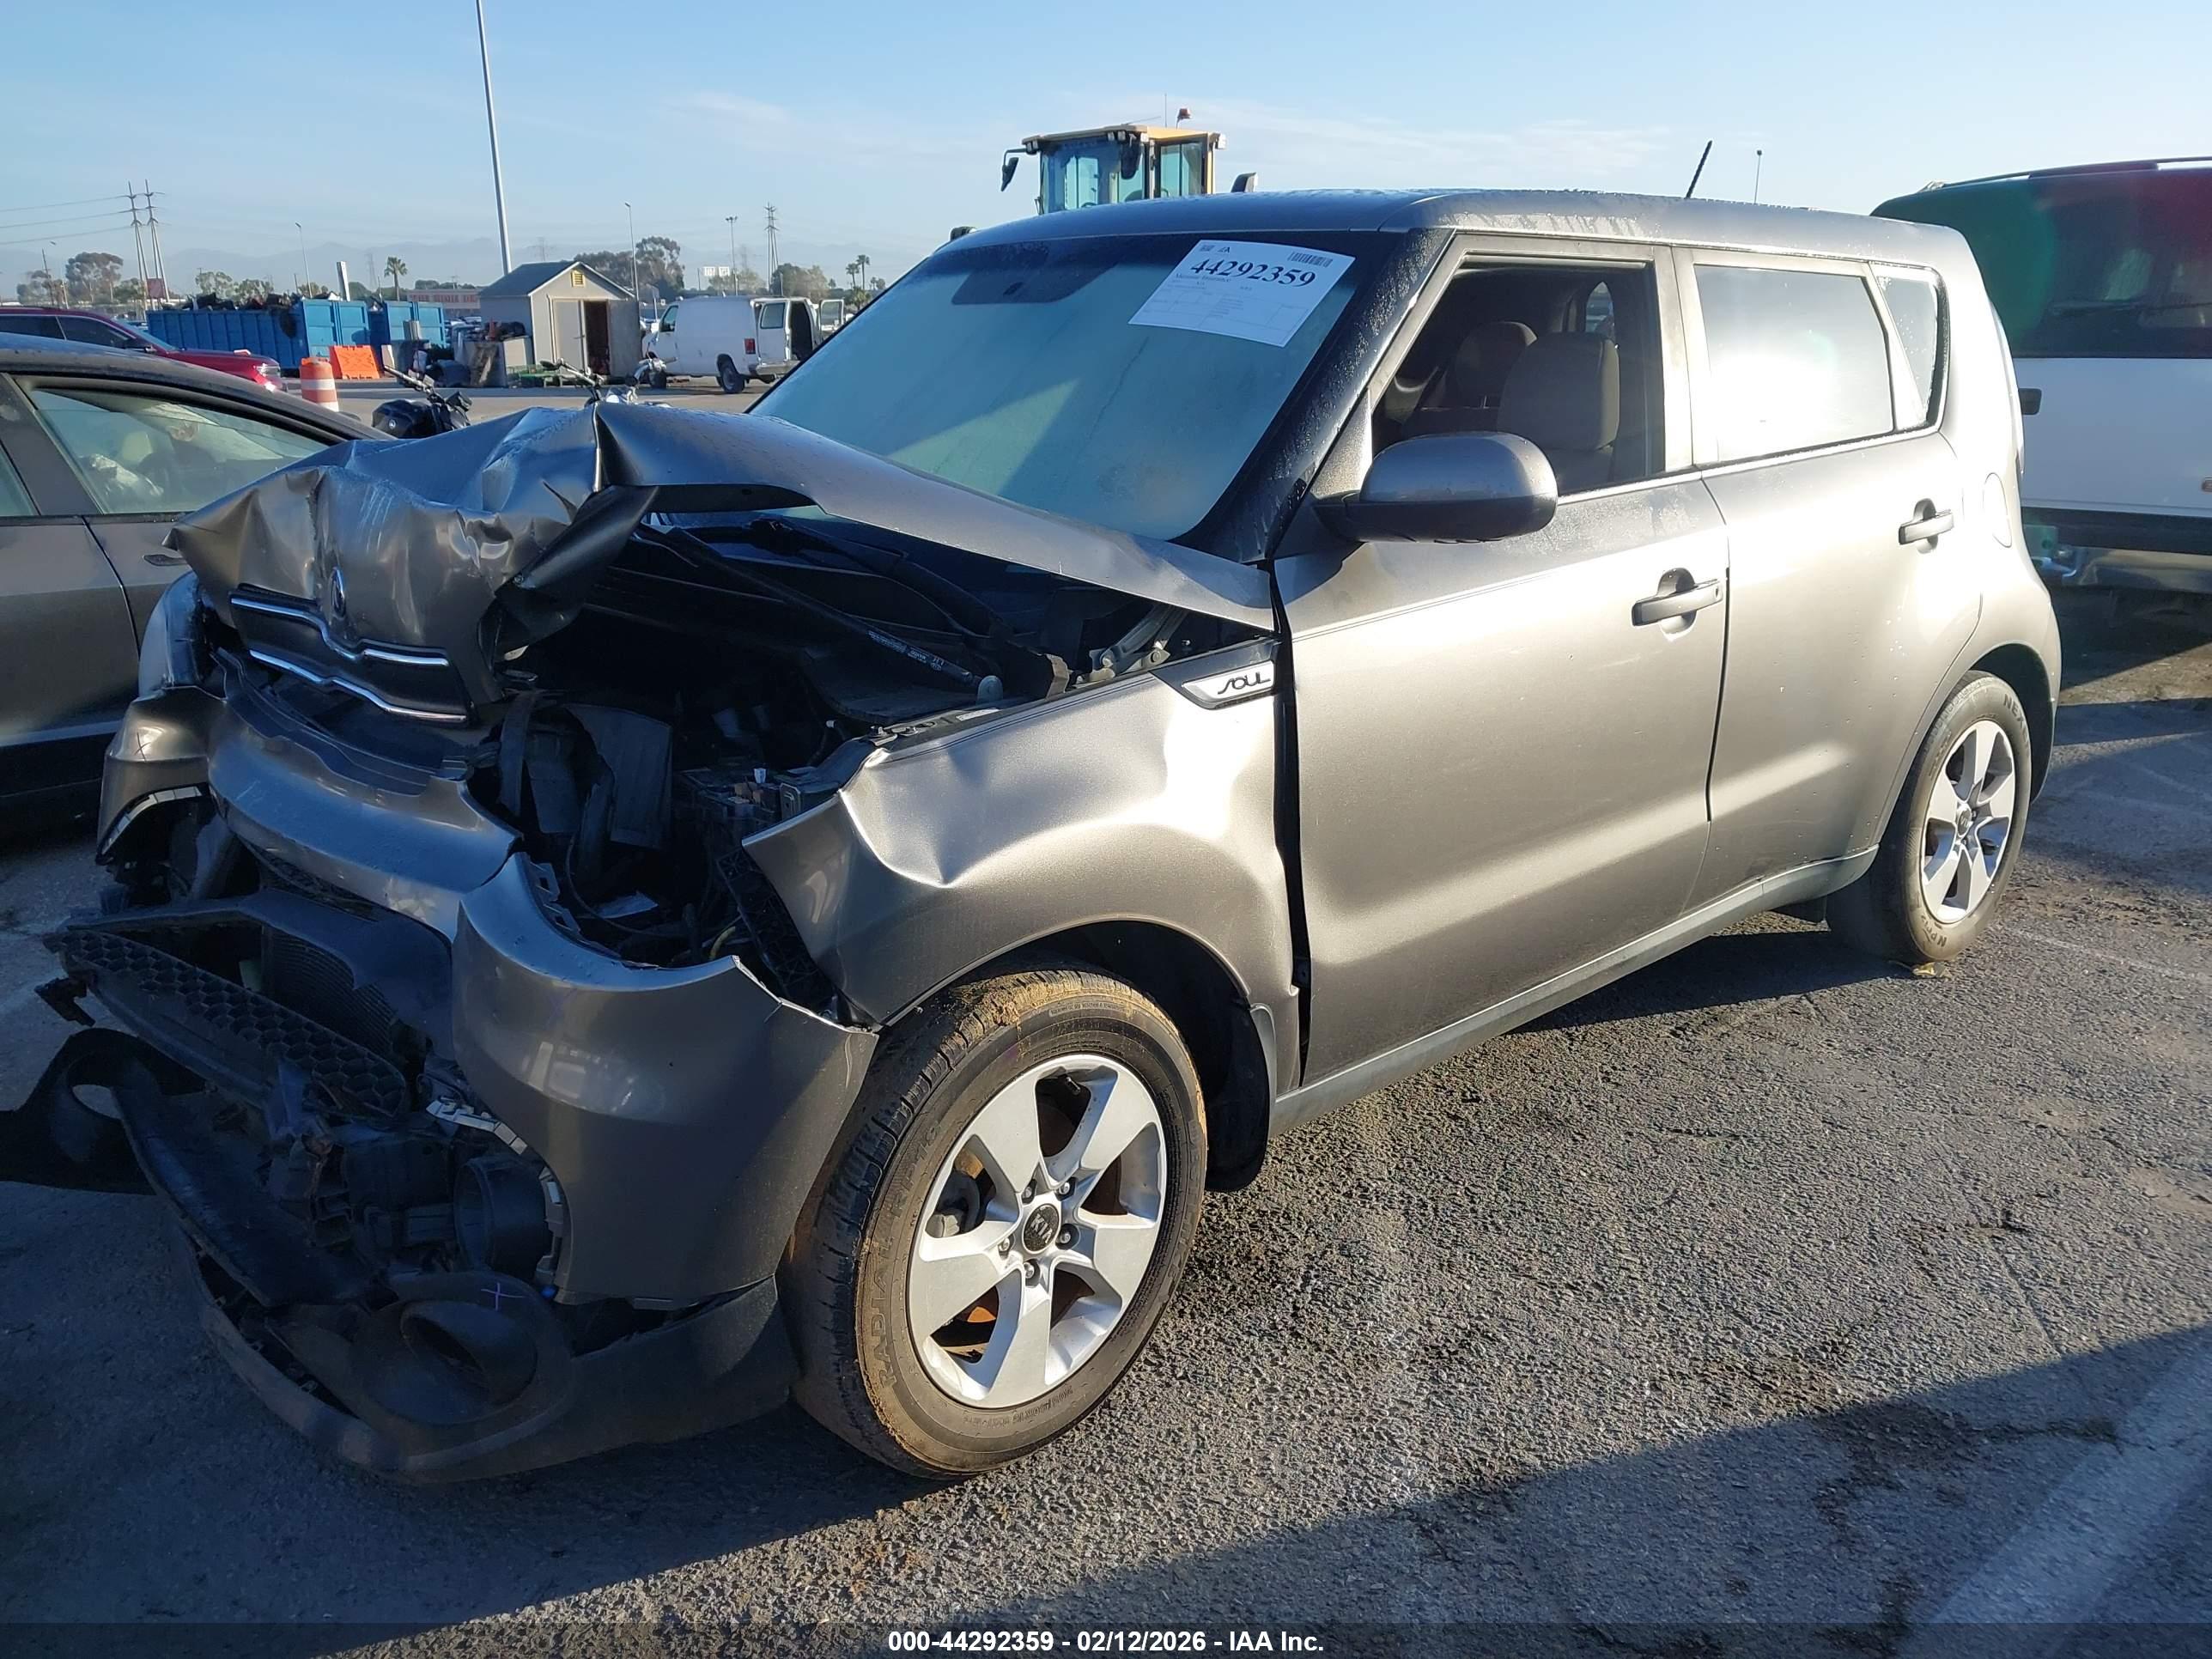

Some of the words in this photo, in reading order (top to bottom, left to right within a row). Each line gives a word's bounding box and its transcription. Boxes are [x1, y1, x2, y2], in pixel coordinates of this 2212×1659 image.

[1190, 258, 1316, 288] 44292359
[1217, 671, 1272, 696] SOUL
[1030, 1212, 1054, 1244] KIA
